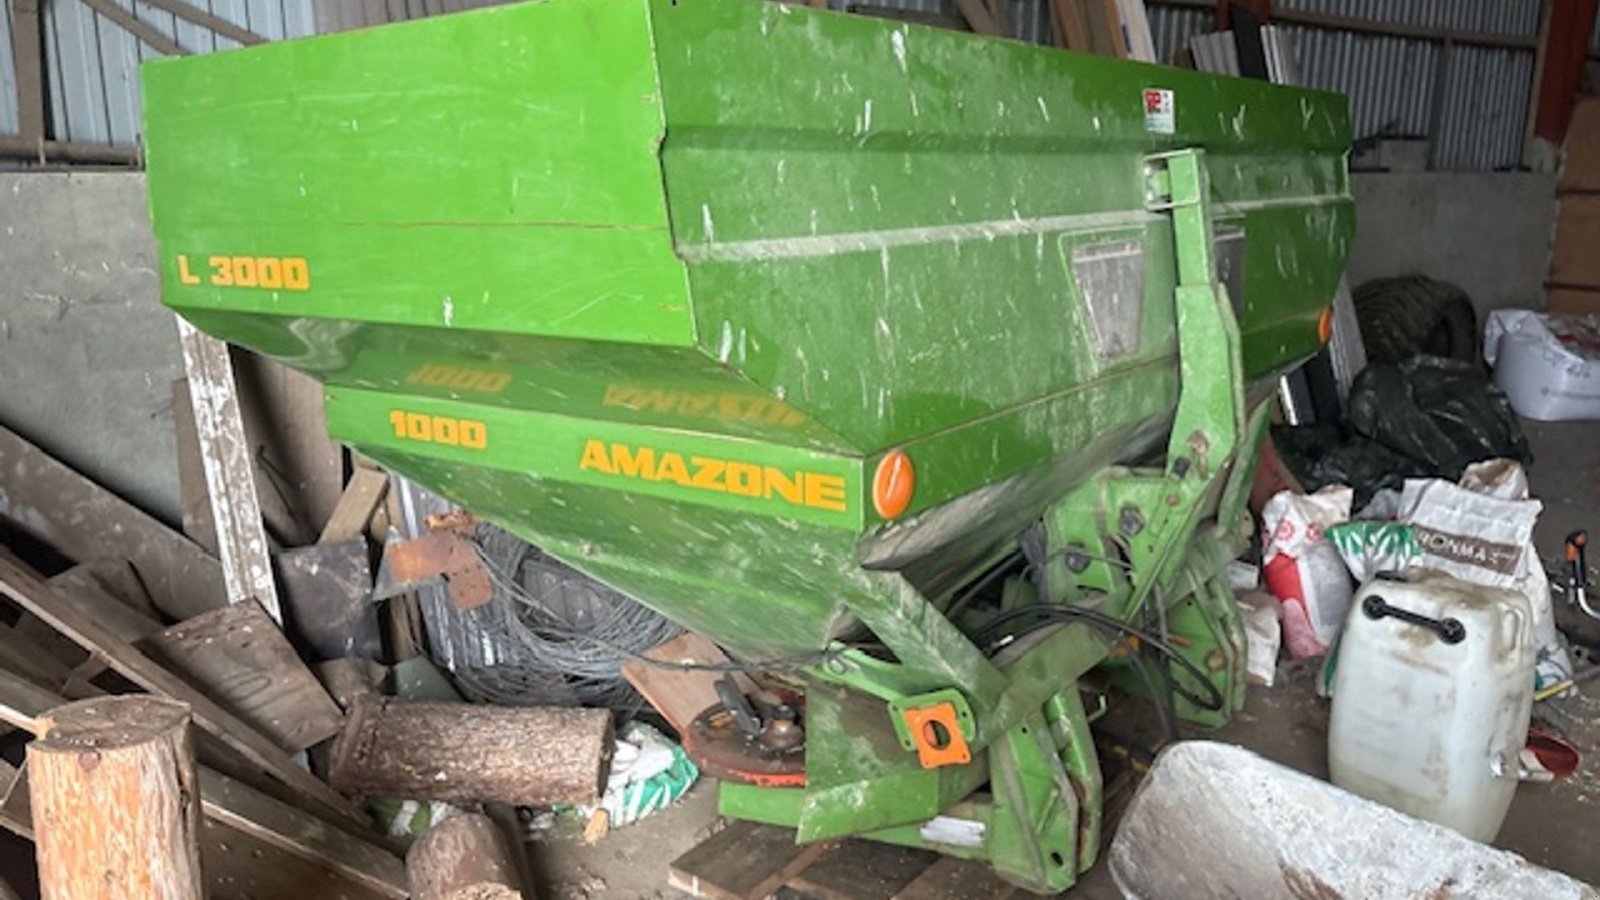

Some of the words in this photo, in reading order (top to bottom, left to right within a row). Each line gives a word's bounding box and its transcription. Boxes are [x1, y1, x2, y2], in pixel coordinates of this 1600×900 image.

[177, 254, 201, 285] L
[208, 255, 310, 291] 3000
[389, 409, 486, 450] 1000
[579, 439, 846, 513] AMAZONE
